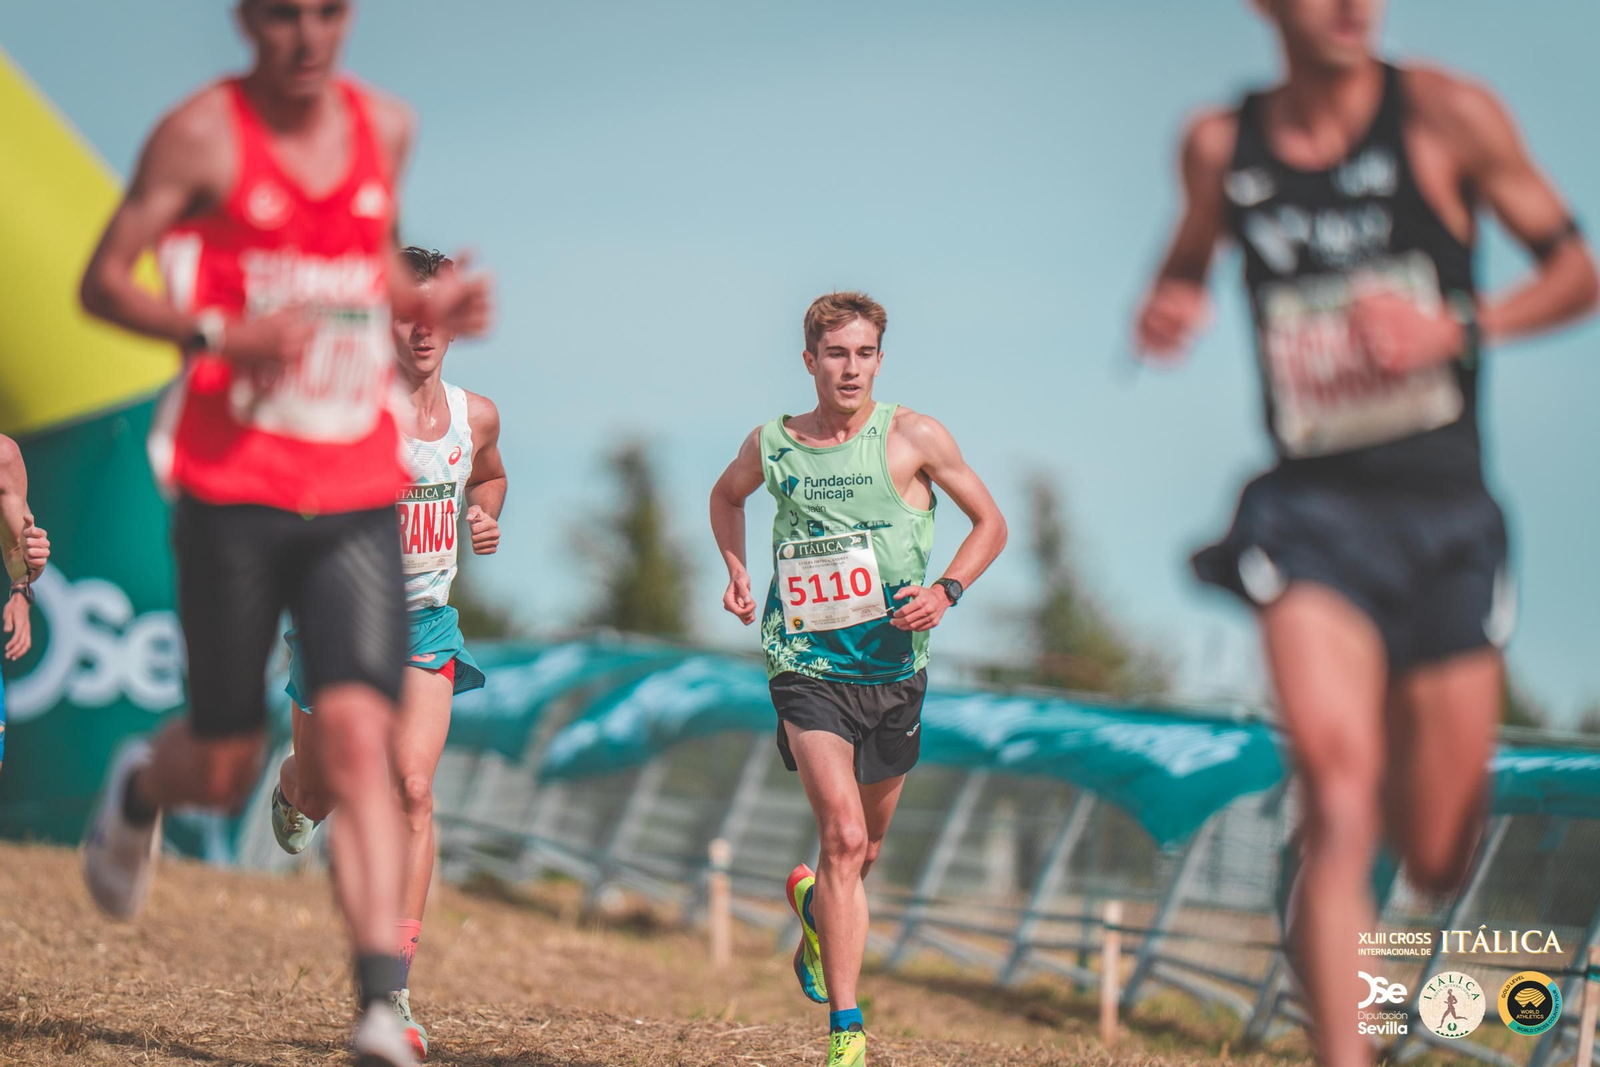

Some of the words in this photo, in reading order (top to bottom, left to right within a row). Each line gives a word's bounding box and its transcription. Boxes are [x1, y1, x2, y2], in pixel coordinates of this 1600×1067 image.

[804, 473, 873, 488] Fundación
[804, 487, 854, 502] Unicaja
[806, 504, 826, 514] Jaén
[799, 540, 844, 556] ITÁLICA
[788, 567, 872, 606] 5110
